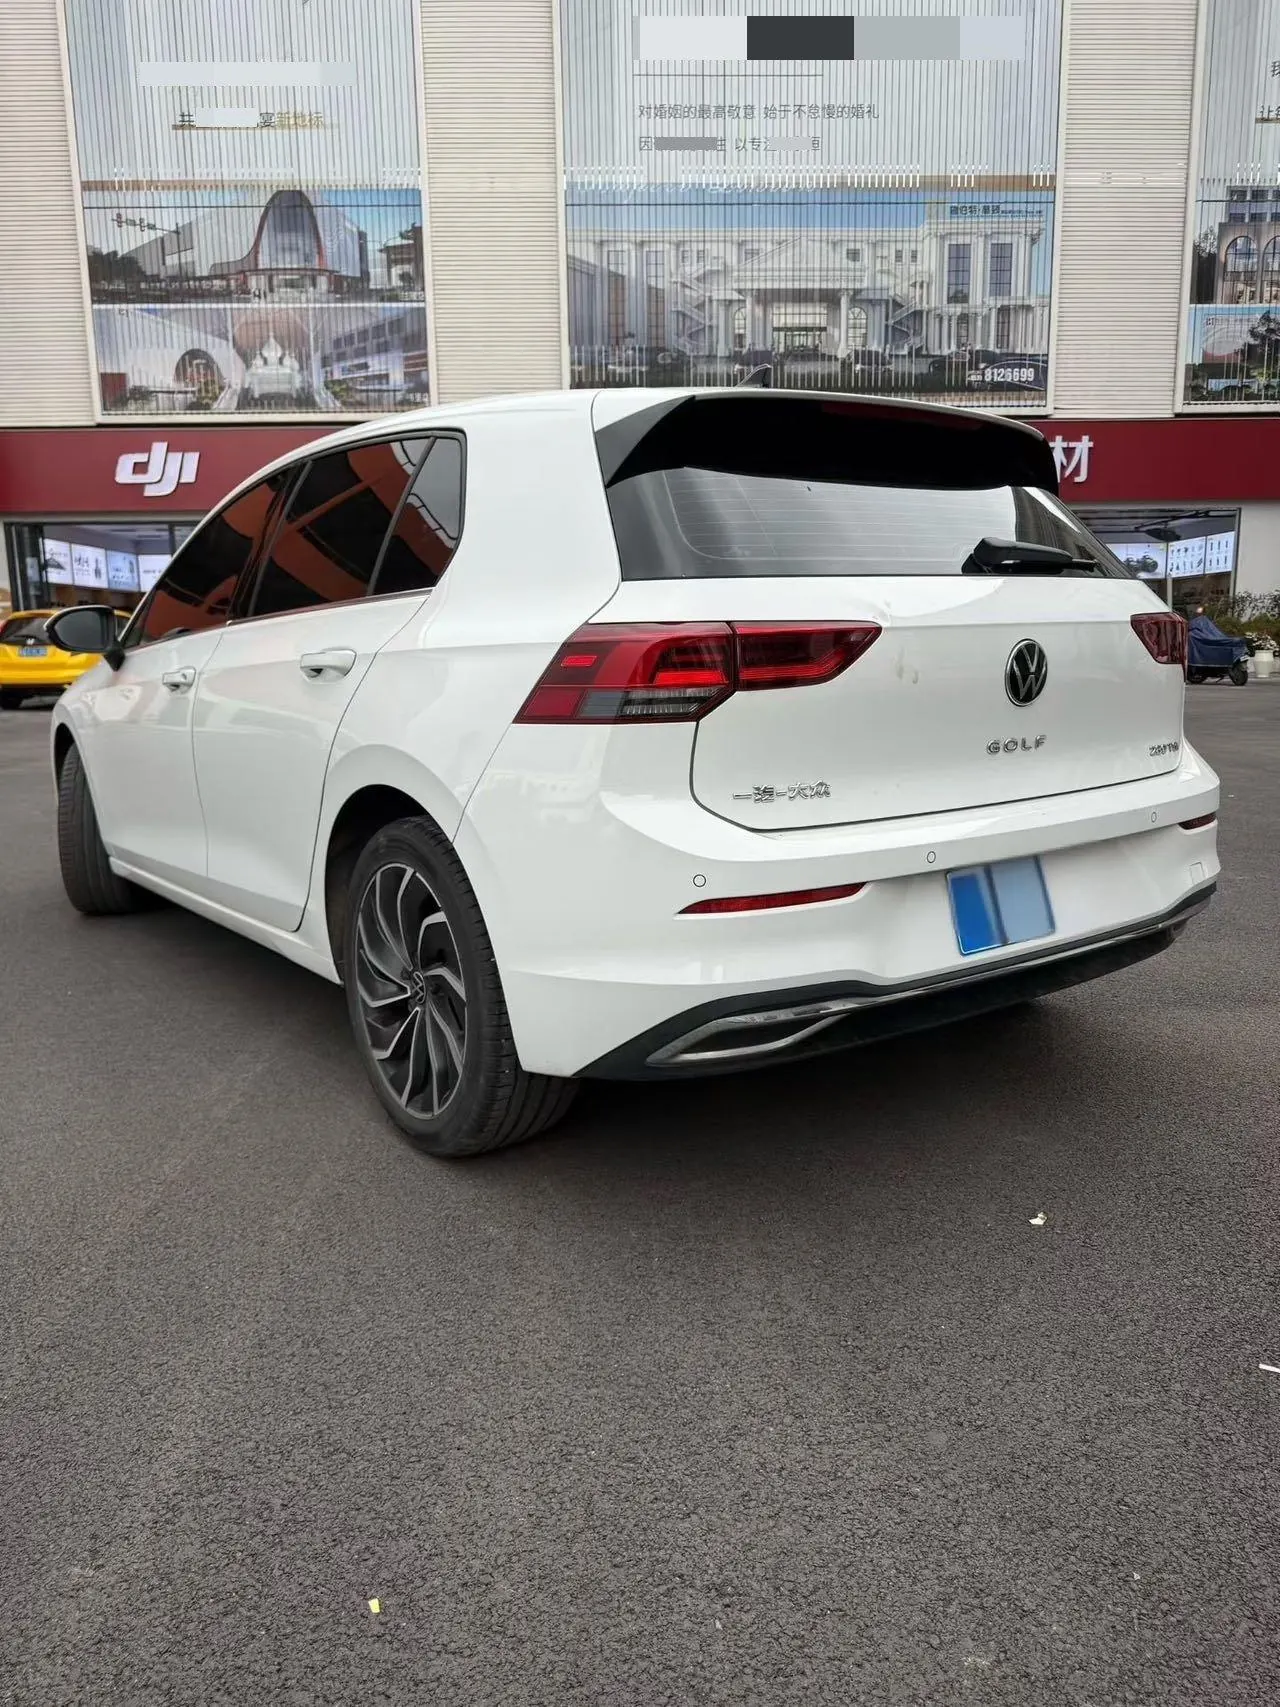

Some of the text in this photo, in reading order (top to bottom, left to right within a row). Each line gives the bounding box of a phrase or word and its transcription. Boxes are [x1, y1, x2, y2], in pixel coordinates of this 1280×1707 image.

[638, 104, 880, 120] 对婚姻的最高敬意 始于不怠慢的婚礼
[1049, 435, 1094, 483] 材
[986, 734, 1047, 755] GOLF
[733, 780, 831, 804] 一汽-大众
